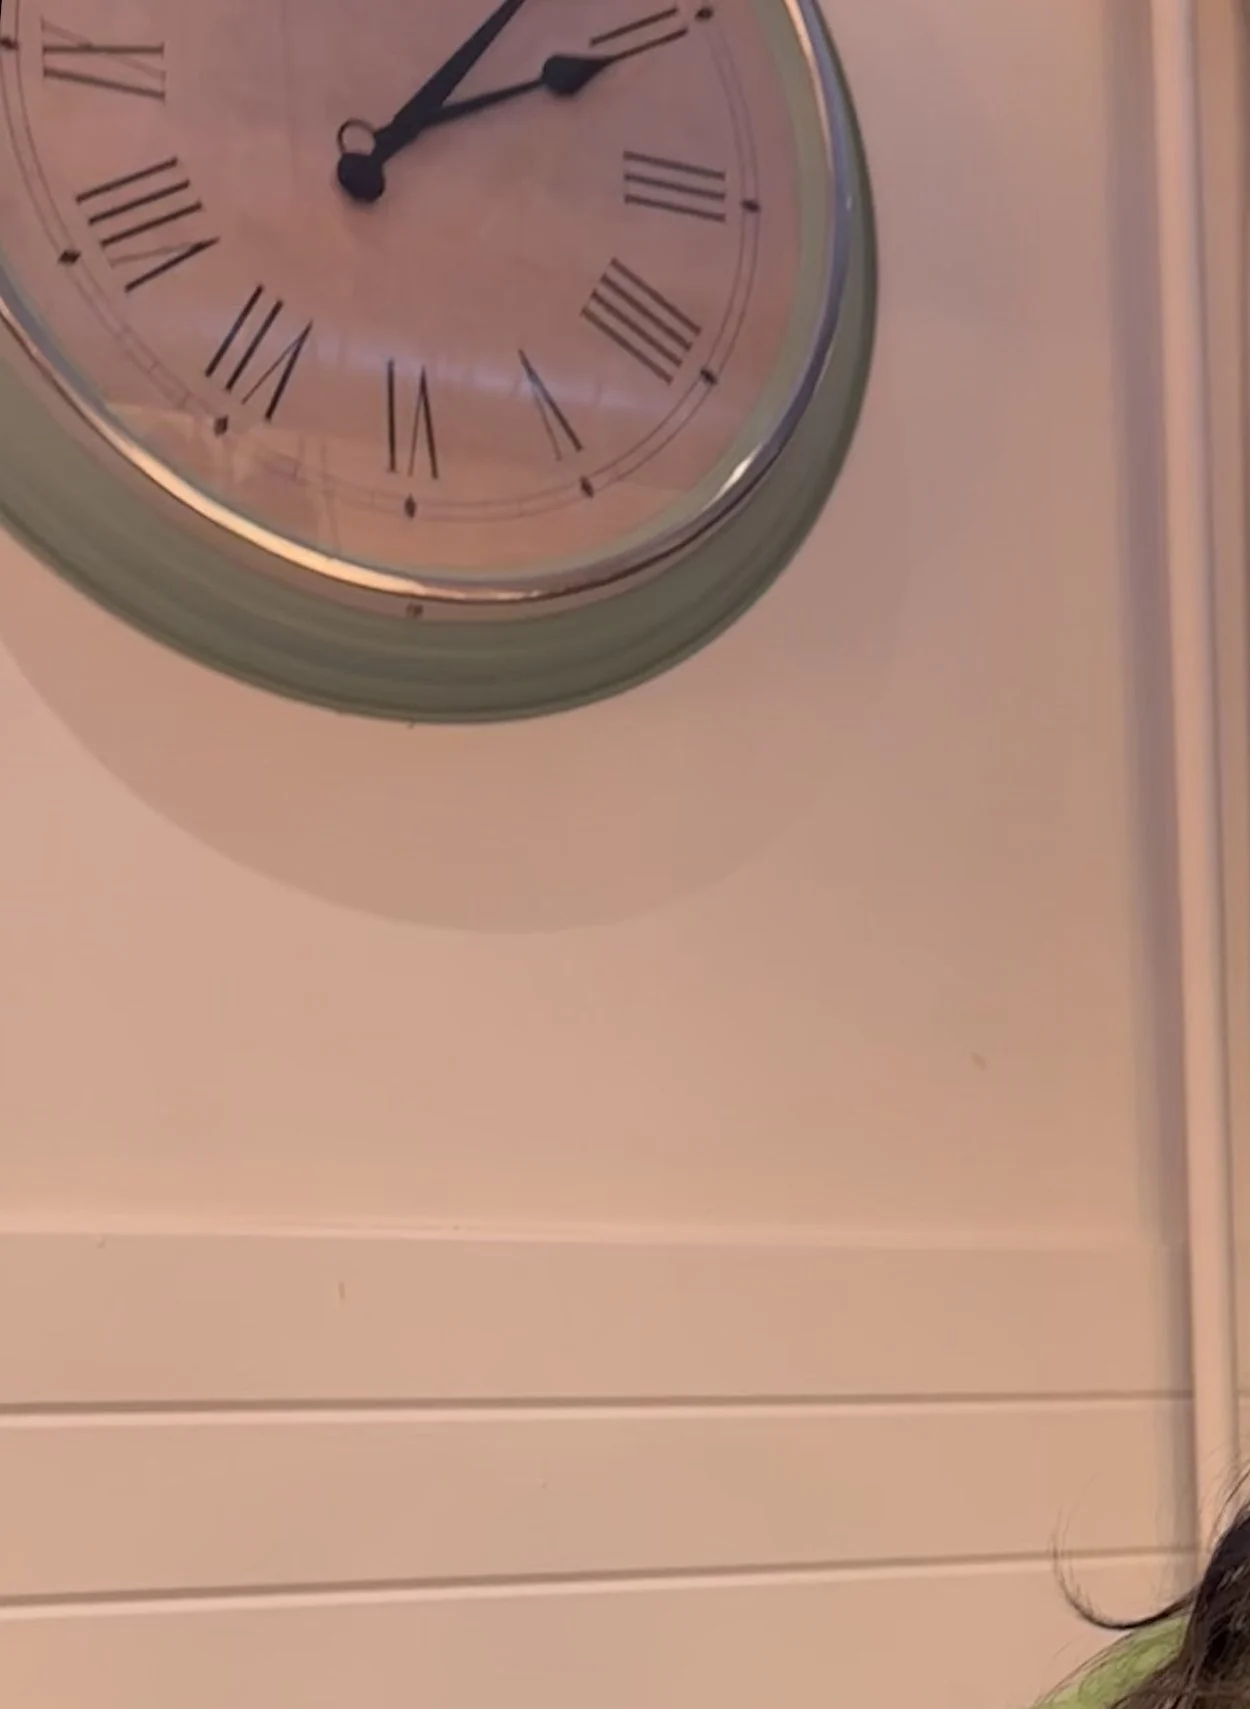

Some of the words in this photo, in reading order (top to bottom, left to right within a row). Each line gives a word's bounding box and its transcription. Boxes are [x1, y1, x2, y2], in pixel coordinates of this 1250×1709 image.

[74, 156, 221, 294] VIII
[622, 150, 727, 223] III
[203, 283, 314, 423] VII
[579, 256, 703, 387] IIII
[385, 356, 439, 481] VI
[518, 349, 584, 462] V
